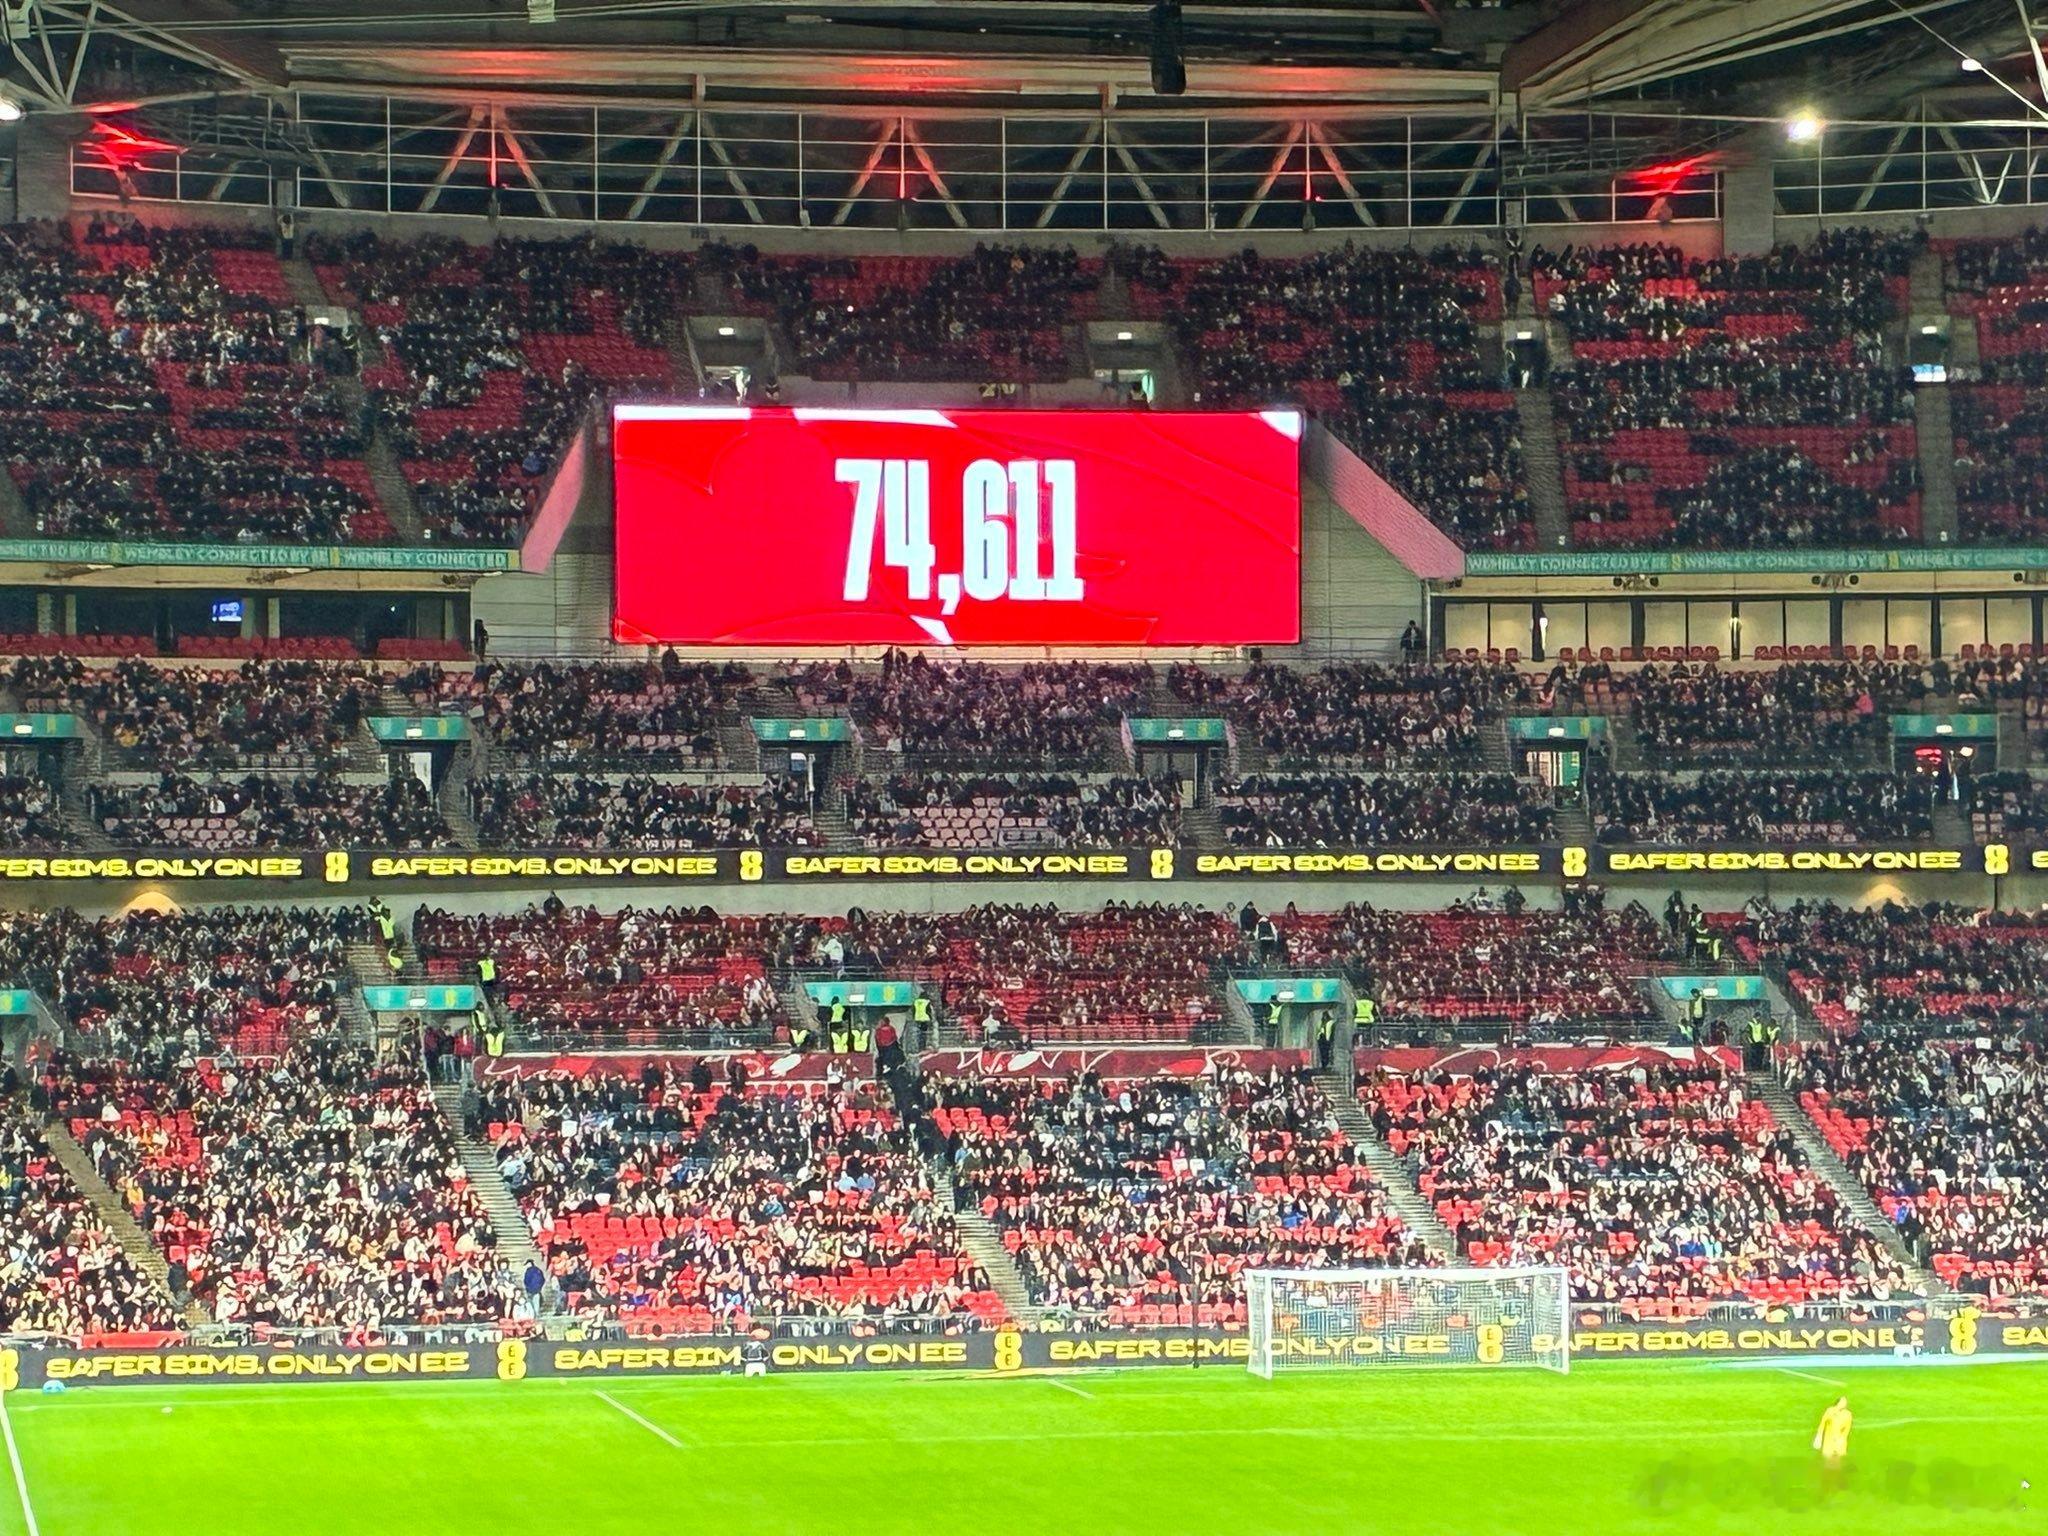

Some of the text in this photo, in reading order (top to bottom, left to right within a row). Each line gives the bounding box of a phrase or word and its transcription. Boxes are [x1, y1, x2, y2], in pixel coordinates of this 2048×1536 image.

[834, 458, 1085, 616] 74,611
[50, 858, 132, 877] SIMS.
[134, 858, 211, 876] ONLY
[260, 858, 301, 876] EE
[371, 858, 468, 876] SAFER
[470, 857, 551, 876] SIMS.
[553, 857, 629, 875] ONLY
[677, 857, 717, 875] EE
[786, 856, 881, 874] SAFER
[882, 856, 963, 874] SIMS.
[965, 856, 1041, 874] ONLY
[1088, 855, 1127, 873] EE
[1197, 855, 1291, 873] SAFER
[1293, 854, 1373, 872] SIMS.
[1376, 853, 1452, 871] ONLY
[1499, 853, 1540, 871] EE
[1609, 853, 1706, 870] SAFER
[1708, 852, 1789, 870] SIMS.
[1791, 852, 1872, 869] ONLY
[1919, 851, 1961, 869] EE
[1050, 1338, 1161, 1360] SAFER
[1405, 1334, 1451, 1354] EE
[1643, 1330, 1735, 1350] SIMS.
[1737, 1329, 1825, 1349] ONLY
[2003, 1326, 2048, 1347] SA
[46, 1355, 162, 1378] SAFER
[164, 1354, 264, 1376] SIMS.
[268, 1353, 363, 1375] ONLY
[421, 1351, 469, 1373] EE
[554, 1347, 670, 1370] SAFER
[672, 1346, 742, 1368] SIM
[772, 1344, 863, 1366] ONLY
[919, 1342, 967, 1364] EE
